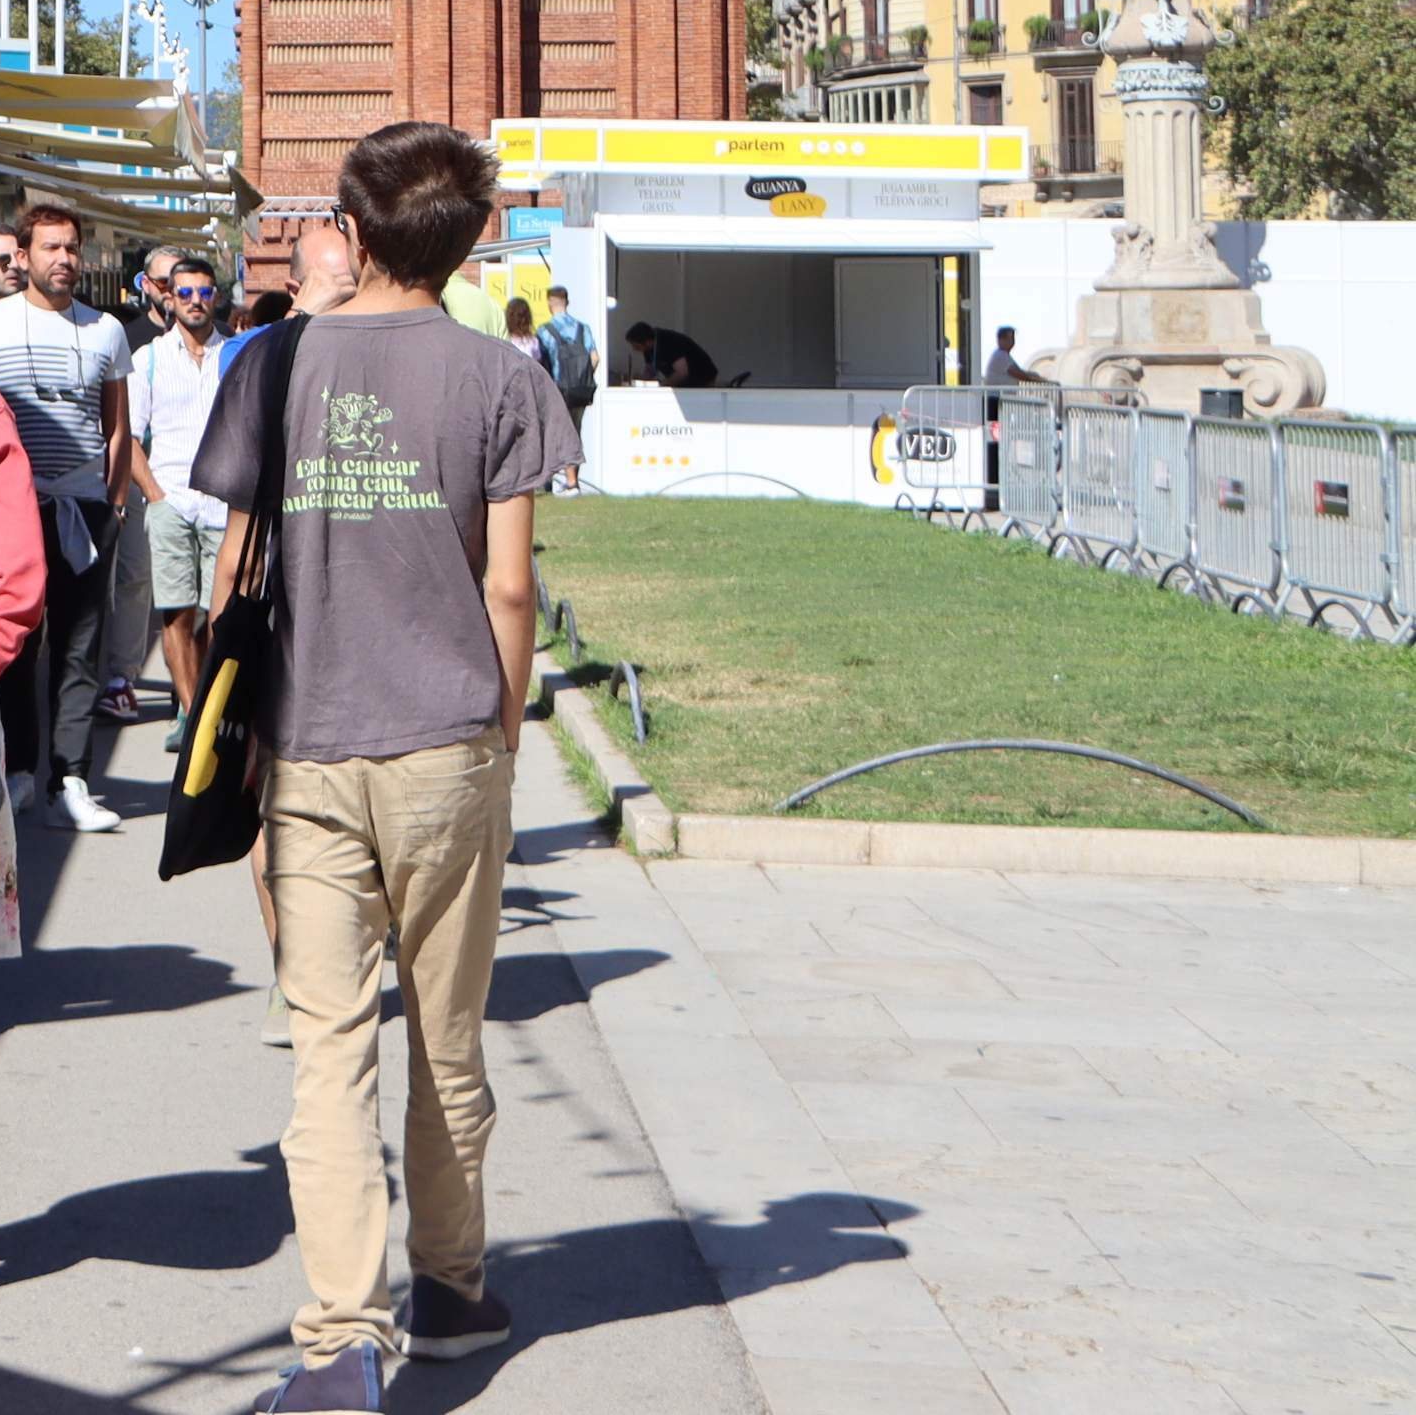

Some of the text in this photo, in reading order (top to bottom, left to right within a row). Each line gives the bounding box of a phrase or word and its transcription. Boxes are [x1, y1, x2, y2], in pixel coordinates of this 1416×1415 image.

[728, 138, 785, 153] parlem
[648, 176, 685, 186] PARLEM
[752, 180, 800, 194] GUANYA
[639, 189, 681, 200] TELECOM
[907, 183, 926, 194] AMB
[642, 424, 693, 438] parlem
[905, 435, 953, 457] VEU
[341, 458, 421, 476] caucar
[307, 475, 410, 494] coma cau,
